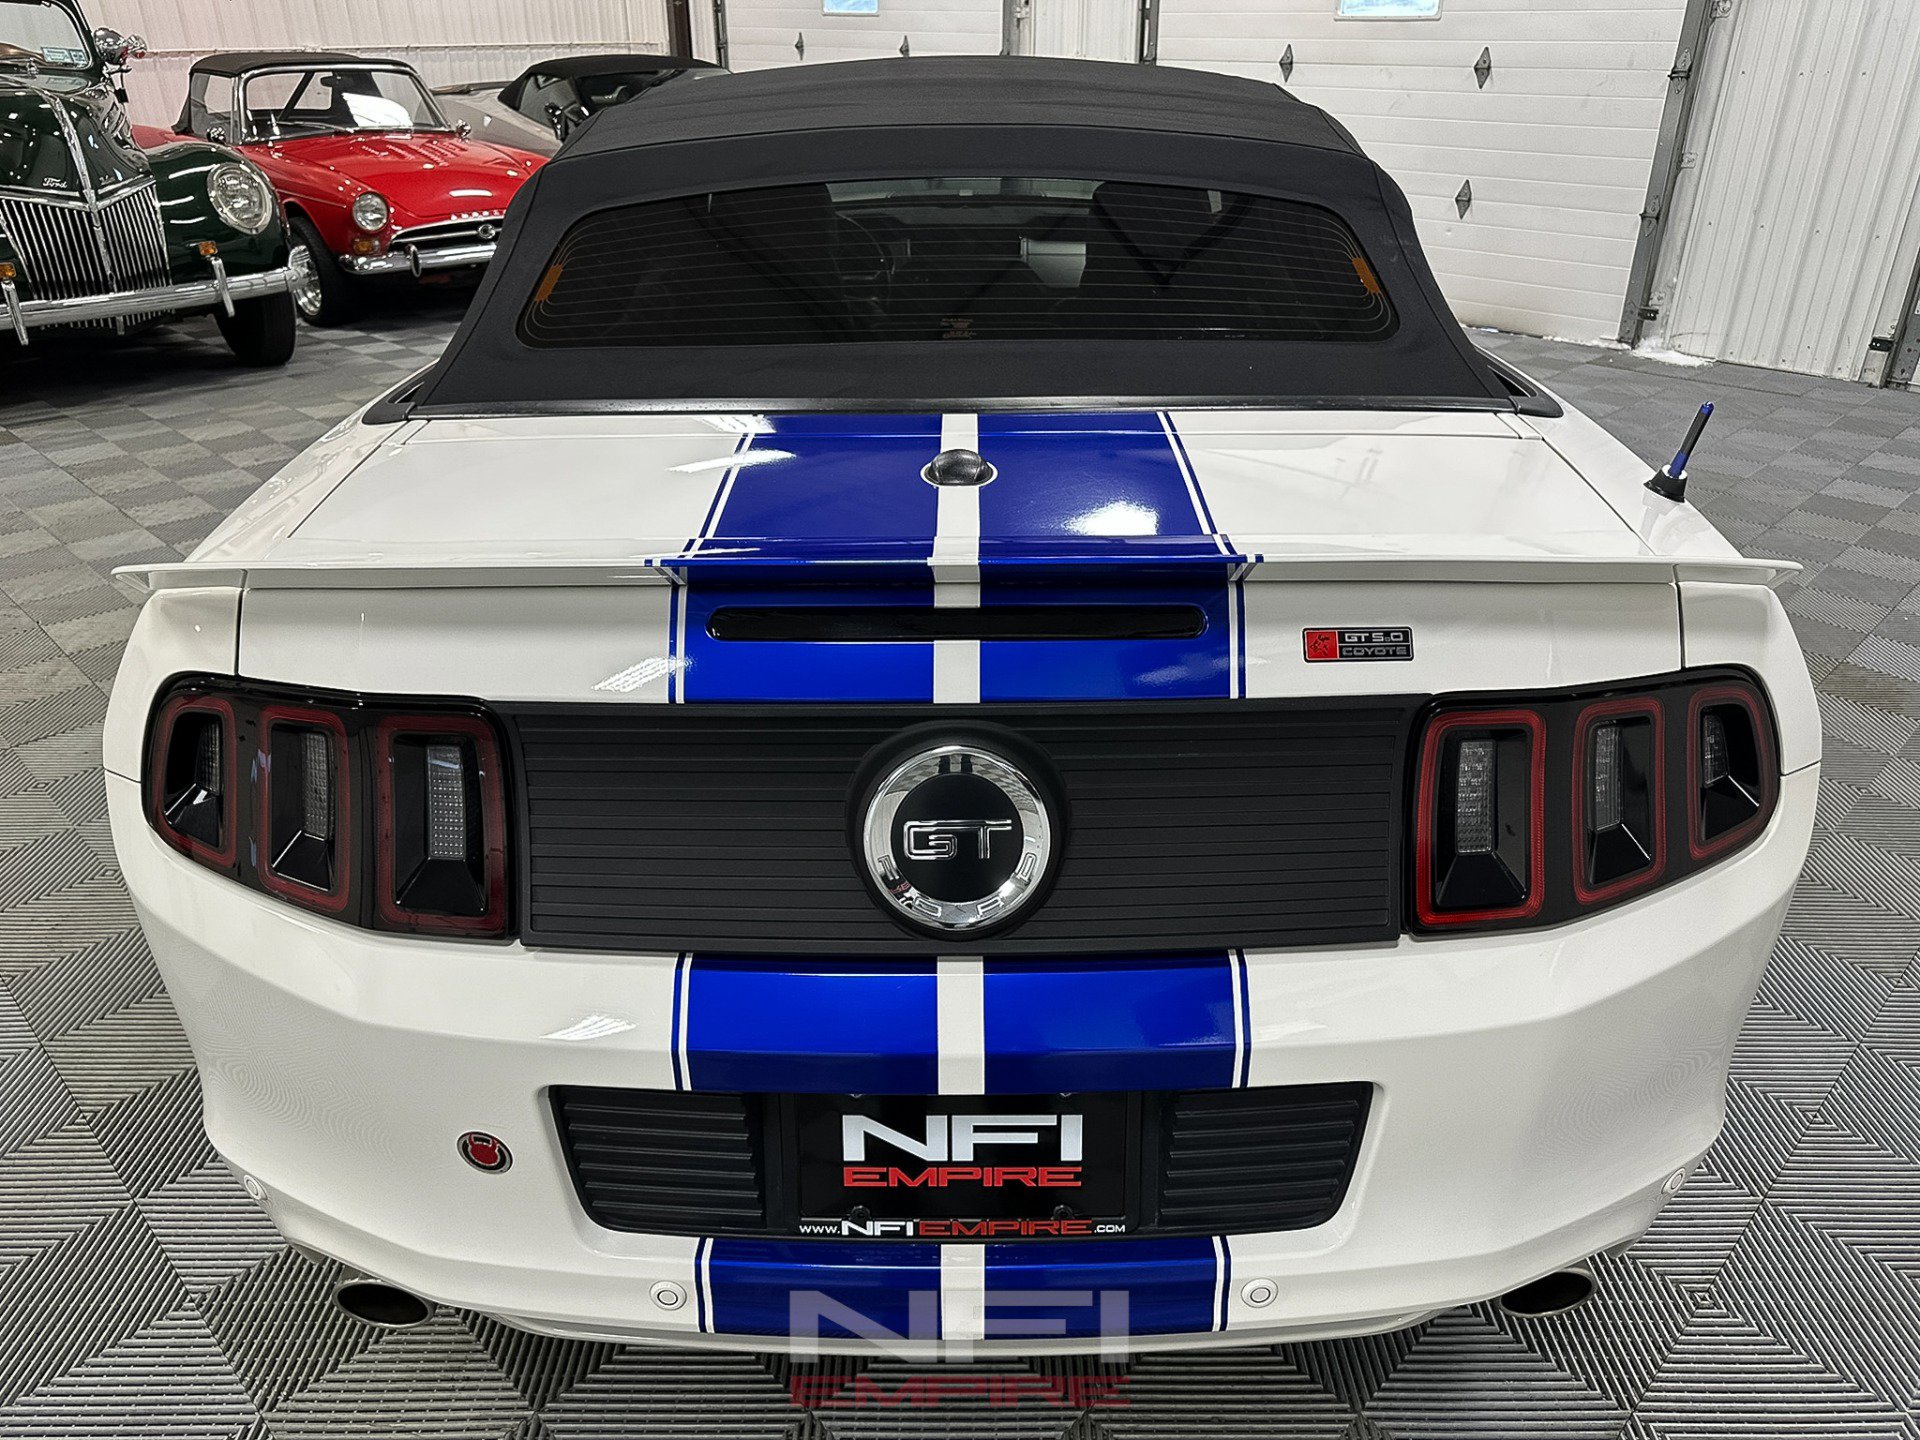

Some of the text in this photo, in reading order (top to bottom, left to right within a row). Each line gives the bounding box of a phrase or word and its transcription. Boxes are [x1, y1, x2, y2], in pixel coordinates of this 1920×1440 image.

[42, 177, 67, 188] Ford
[1345, 632, 1403, 642] GT 5.0
[1342, 646, 1407, 656] COYOTE
[903, 819, 1012, 860] GT
[842, 1114, 1083, 1161] NFI
[843, 1166, 1082, 1187] EMPIRE
